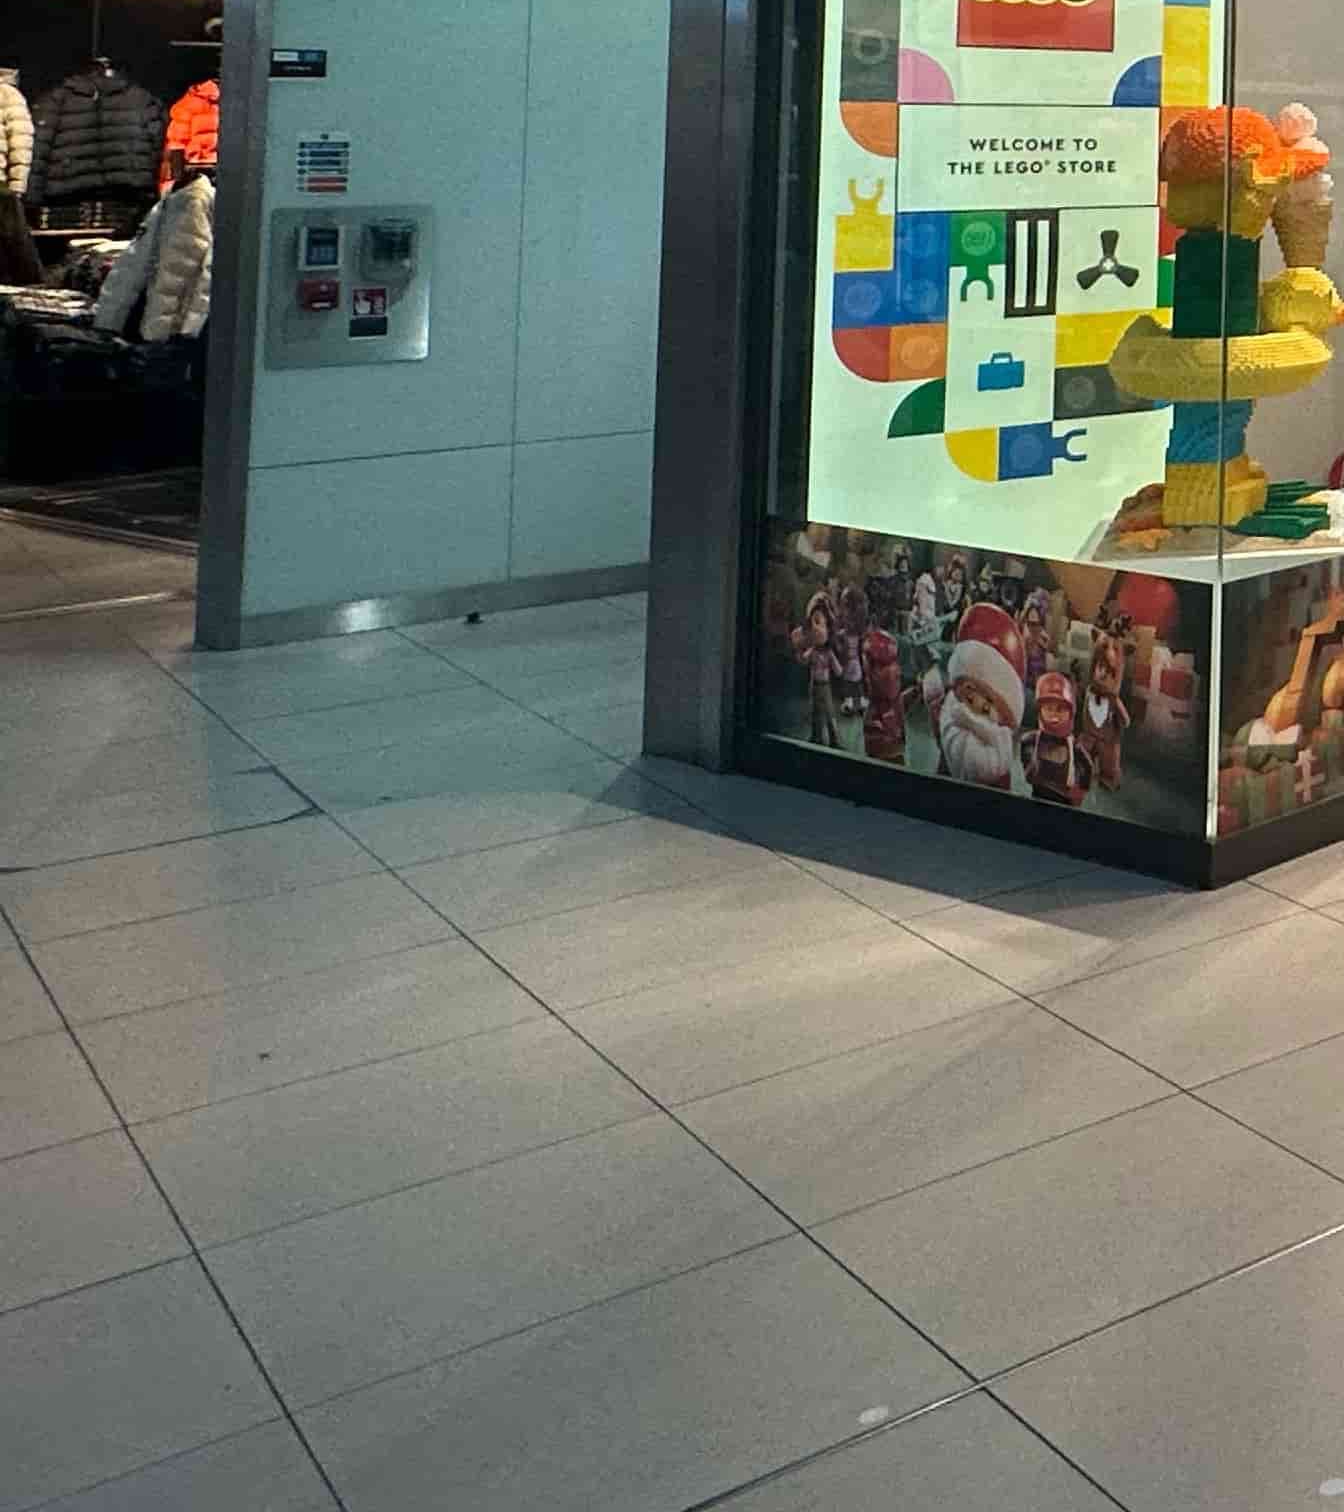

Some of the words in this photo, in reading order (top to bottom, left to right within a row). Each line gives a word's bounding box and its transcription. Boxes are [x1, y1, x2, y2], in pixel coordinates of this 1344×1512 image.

[969, 138, 1066, 152] WELCOME
[1072, 138, 1099, 151] TO
[947, 161, 985, 175] THE
[1056, 160, 1118, 174] STORE
